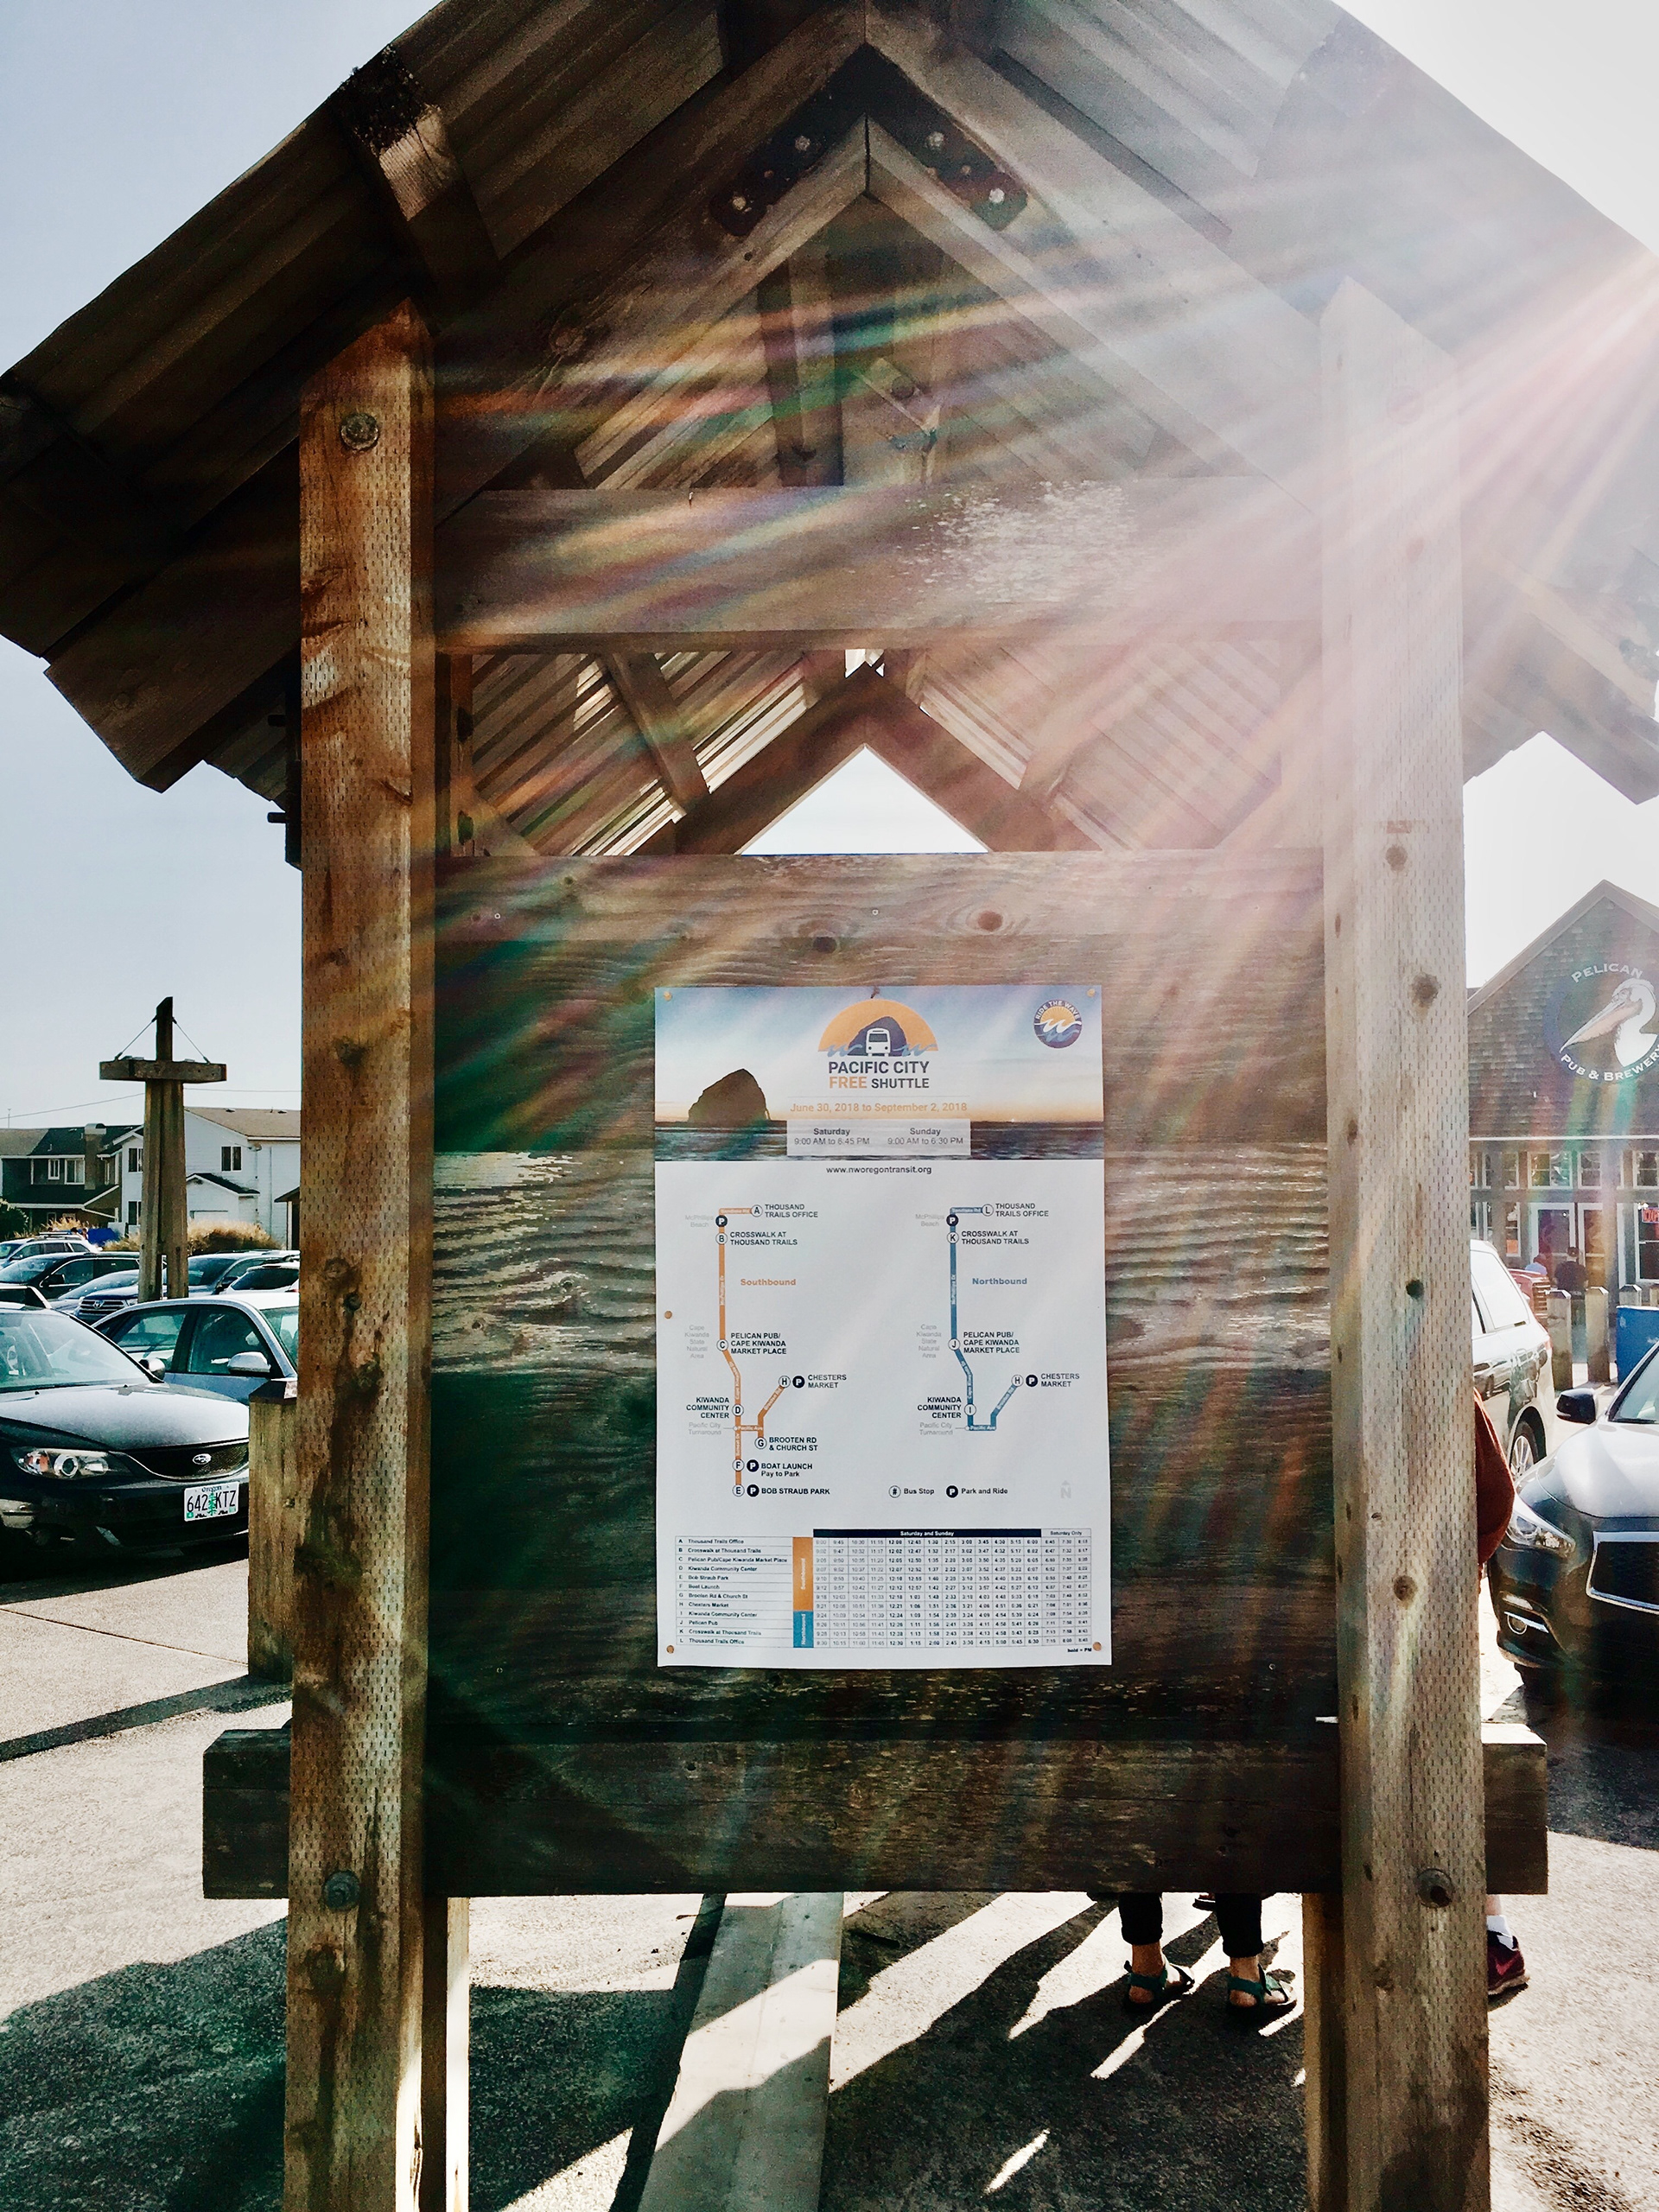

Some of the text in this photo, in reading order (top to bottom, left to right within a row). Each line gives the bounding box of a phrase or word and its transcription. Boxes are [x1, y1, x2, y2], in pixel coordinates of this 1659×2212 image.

[1571, 963, 1643, 983] PELICAN
[1035, 1005, 1048, 1020] RIDE
[1065, 1002, 1080, 1020] WAVE
[829, 1061, 930, 1074] PACIFIC CITY
[1560, 1053, 1586, 1075] PUB
[1588, 1070, 1599, 1080] &
[830, 1076, 930, 1089] FREE SHUTTLE
[817, 1103, 831, 1113] 30,
[874, 1103, 928, 1113] September
[931, 1103, 940, 1112] 2,
[942, 1103, 968, 1111] 2018
[813, 1128, 850, 1136] Saturday
[910, 1128, 941, 1136] Sunday
[187, 1490, 237, 1512] 642 KTZ
